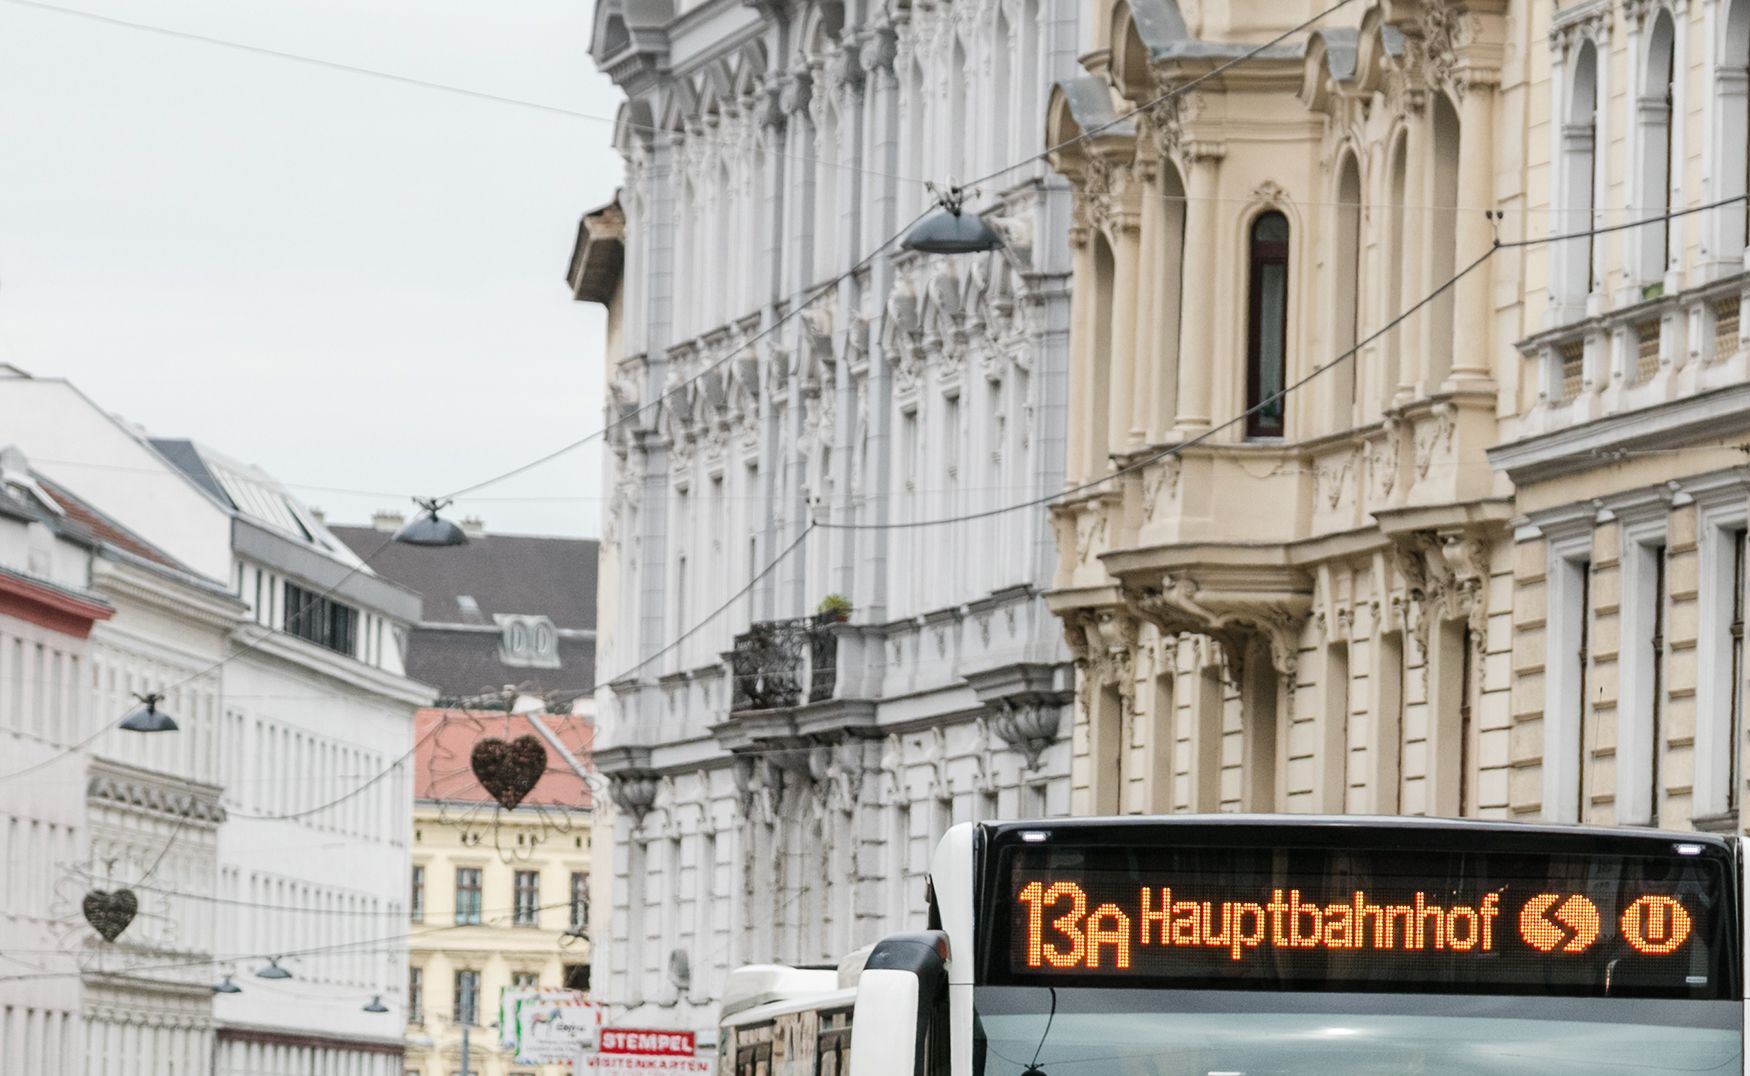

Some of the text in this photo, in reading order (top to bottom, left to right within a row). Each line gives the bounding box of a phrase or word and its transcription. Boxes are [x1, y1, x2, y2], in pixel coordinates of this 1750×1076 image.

[1019, 881, 1130, 968] 13A
[1140, 886, 1500, 960] Hauptbahnhof
[602, 1031, 692, 1052] STEMPEL
[587, 1056, 708, 1071] VISITENKARTEN
